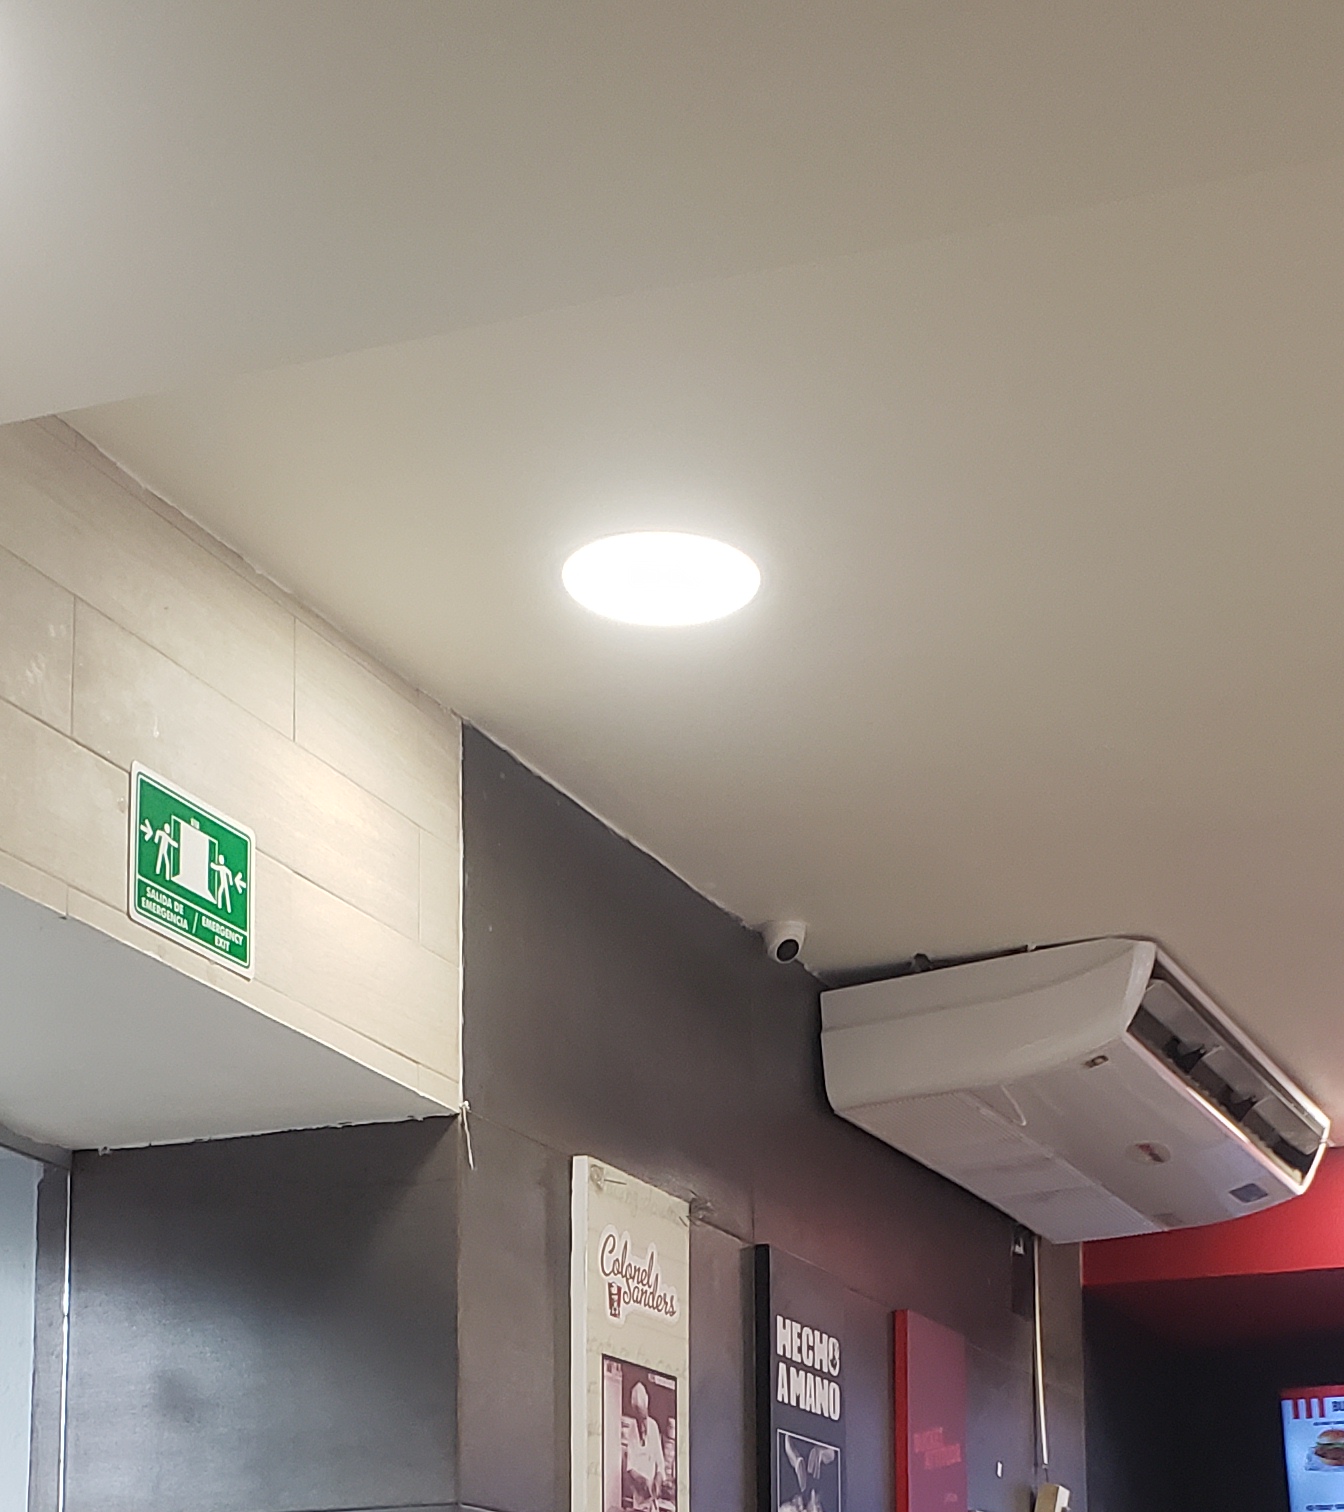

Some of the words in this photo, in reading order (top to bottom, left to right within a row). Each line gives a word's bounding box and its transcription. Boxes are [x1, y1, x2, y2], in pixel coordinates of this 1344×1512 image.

[141, 897, 189, 930] EMERGENCIA
[146, 886, 172, 910] SALIDA
[174, 901, 184, 915] DE
[202, 916, 243, 946] EMERGENCY
[214, 935, 230, 952] EXIT
[600, 1233, 654, 1289] Colonel
[623, 1272, 676, 1317] Sanders
[776, 1314, 841, 1377] HECHO
[777, 1361, 789, 1405] A
[789, 1366, 841, 1421] MANO
